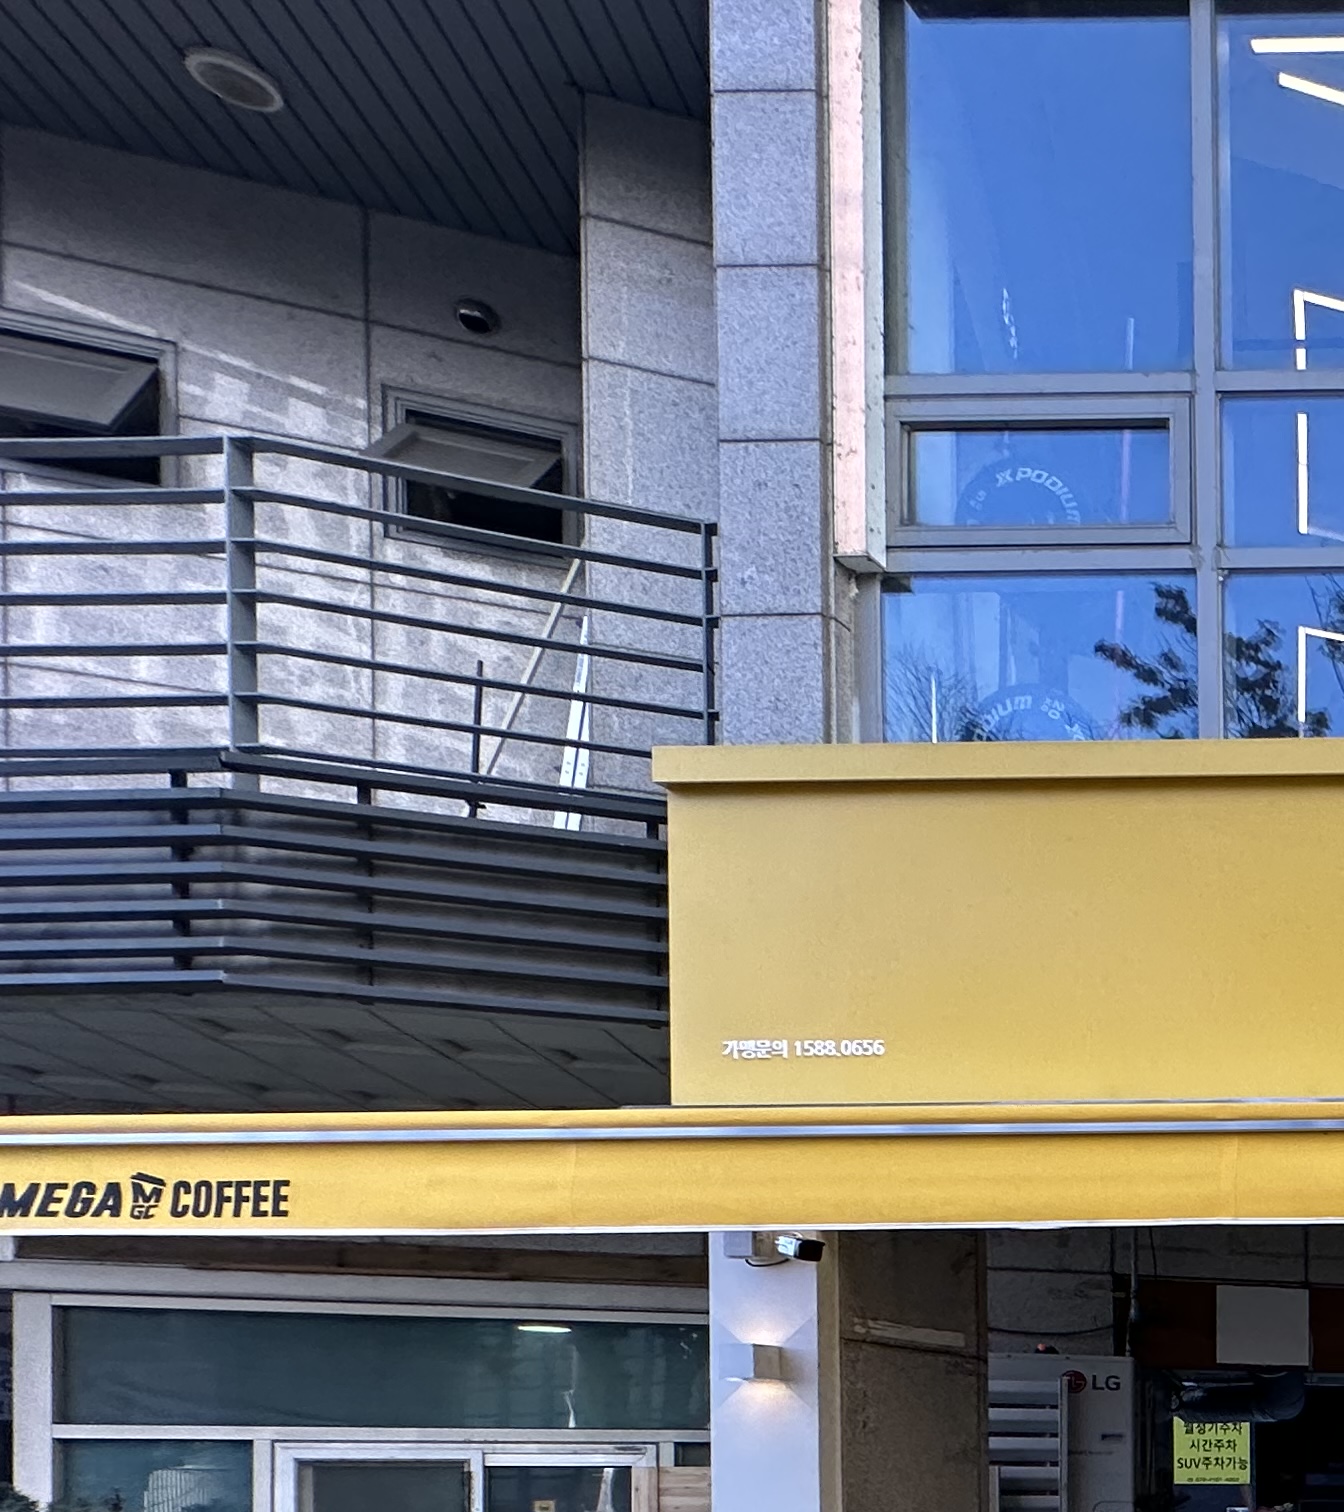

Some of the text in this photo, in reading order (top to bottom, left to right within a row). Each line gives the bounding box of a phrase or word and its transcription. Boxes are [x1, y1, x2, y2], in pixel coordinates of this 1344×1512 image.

[721, 1039, 885, 1060] 가맹문의 1588.0656
[0, 1181, 122, 1218] MEGA
[170, 1180, 290, 1218] COFFEE
[1091, 1374, 1121, 1391] LG
[1189, 1438, 1238, 1453] 시간주차
[1177, 1456, 1248, 1471] SUV주차가능
